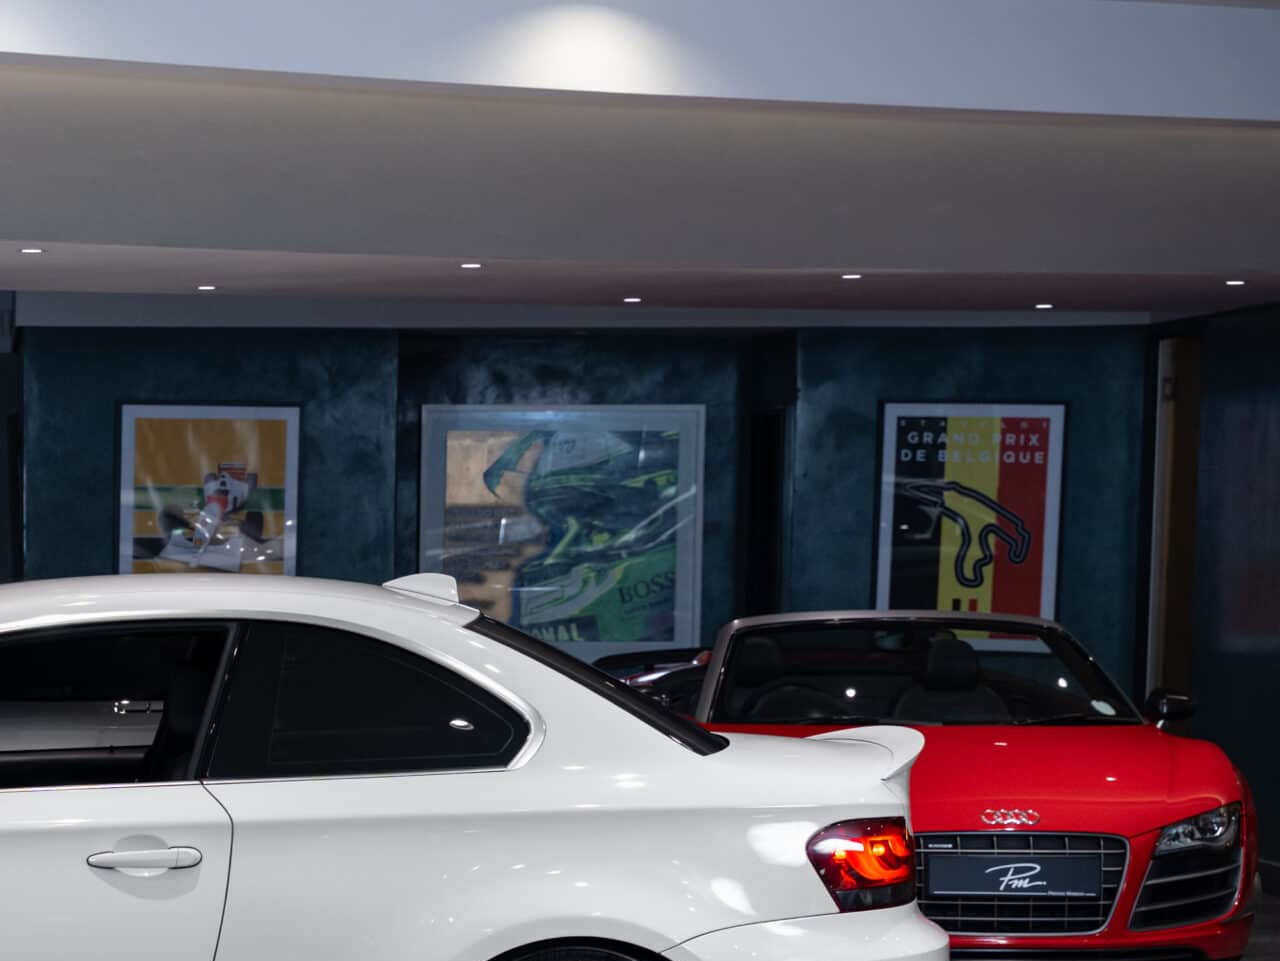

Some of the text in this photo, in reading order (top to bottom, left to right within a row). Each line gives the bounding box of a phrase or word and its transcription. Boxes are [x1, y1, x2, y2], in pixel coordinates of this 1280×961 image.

[907, 431, 1041, 447] GRAND PRIX
[900, 449, 1045, 464] DE BELGIQUE
